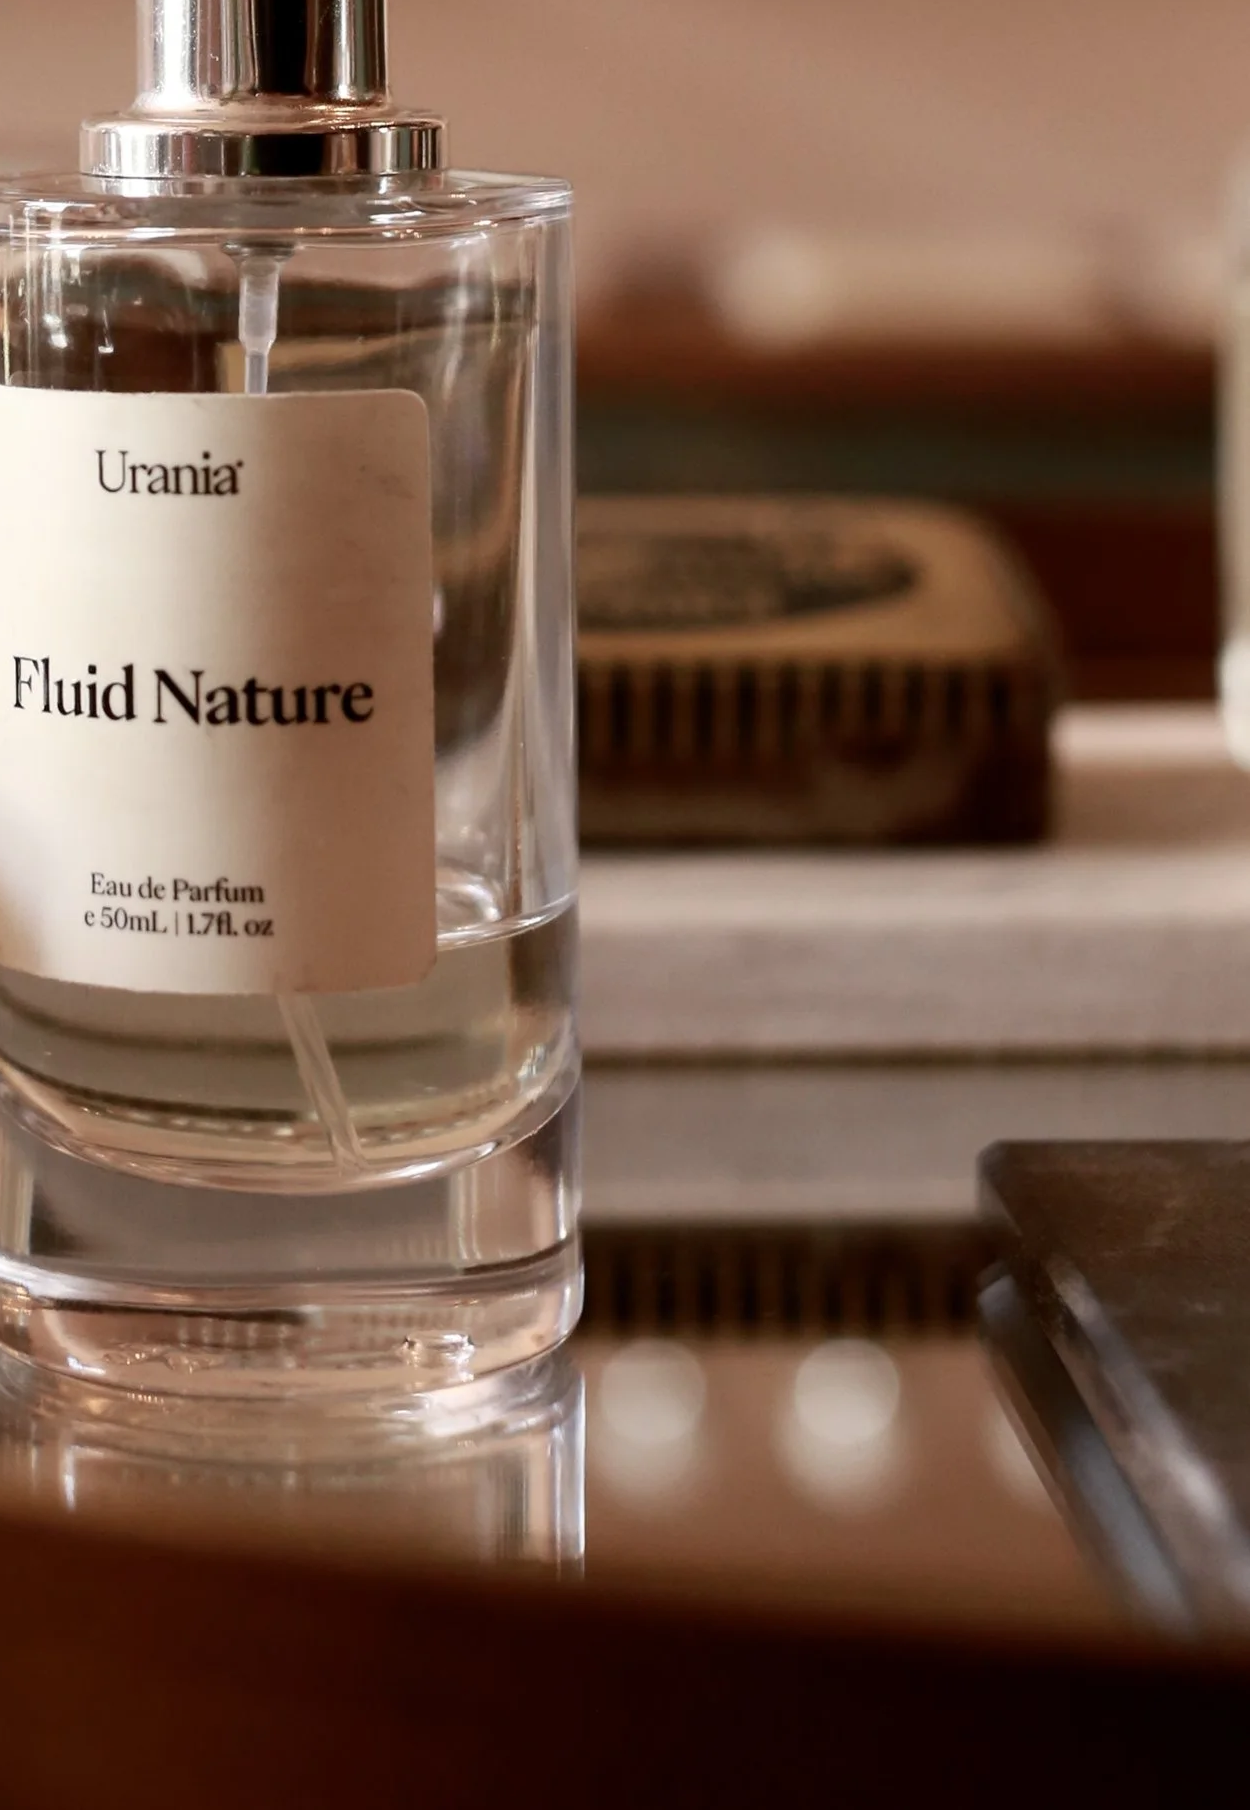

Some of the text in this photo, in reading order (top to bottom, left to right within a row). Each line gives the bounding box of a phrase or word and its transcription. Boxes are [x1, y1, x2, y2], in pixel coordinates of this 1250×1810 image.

[94, 450, 244, 495] Urania
[13, 655, 375, 726] Fluid Nature
[91, 872, 266, 904] Eau de Parfum
[100, 906, 168, 934] 50mL
[244, 919, 275, 937] oz
